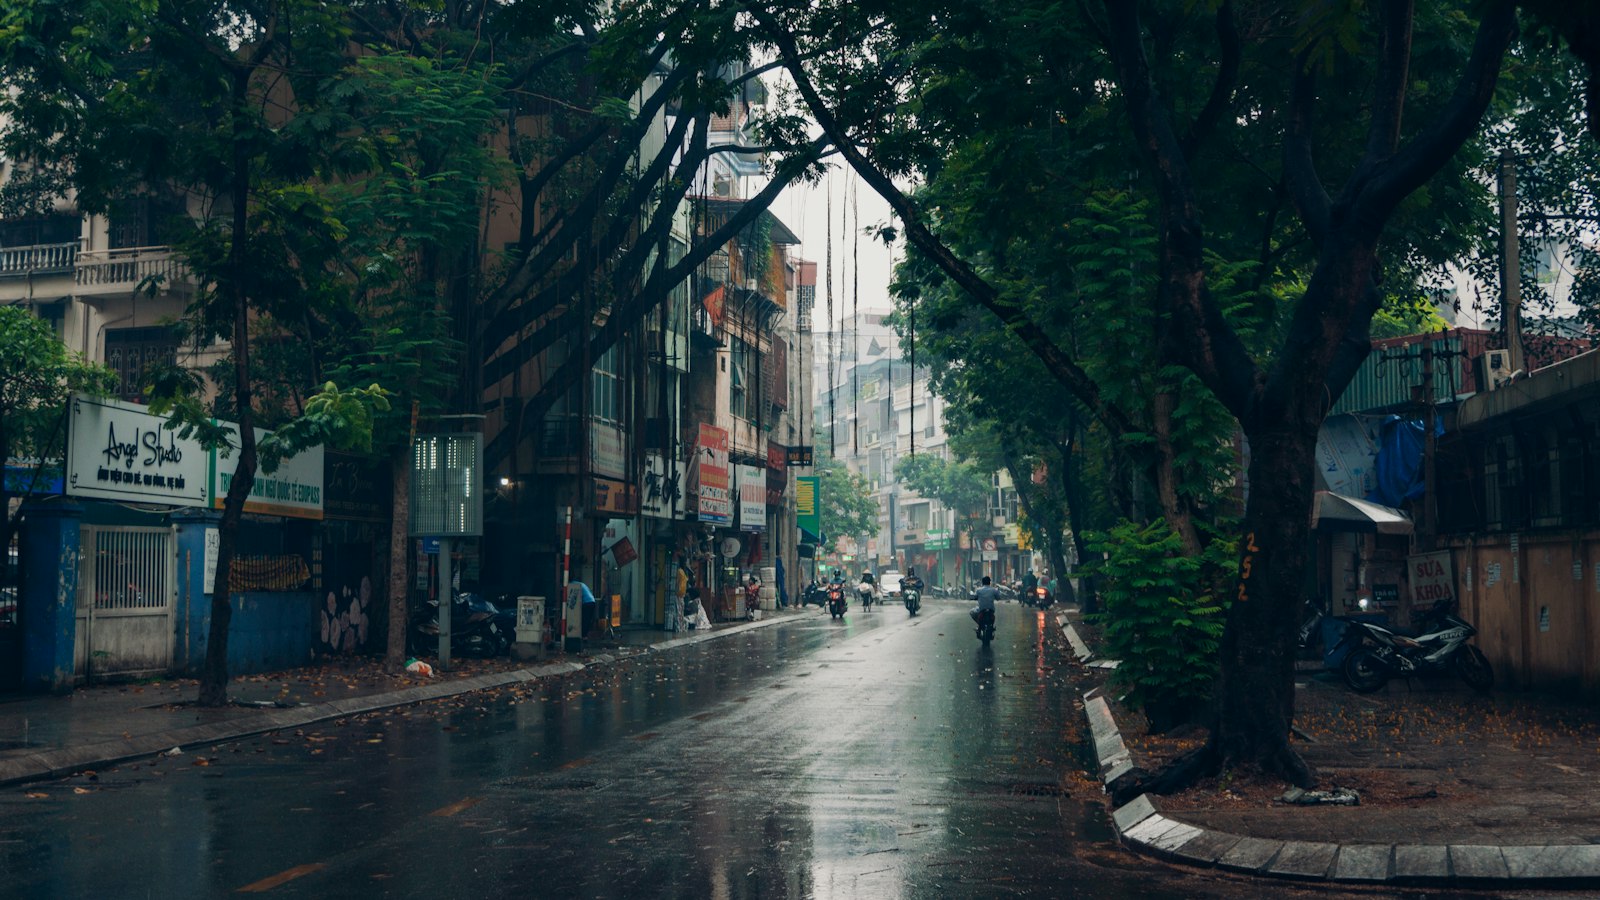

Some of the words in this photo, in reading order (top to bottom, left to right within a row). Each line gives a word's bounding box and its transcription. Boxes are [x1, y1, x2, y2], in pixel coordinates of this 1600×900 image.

[103, 421, 139, 469] Angel
[143, 423, 182, 467] Studio
[797, 480, 815, 516] LAUNDRY
[1416, 556, 1444, 577] SỬA
